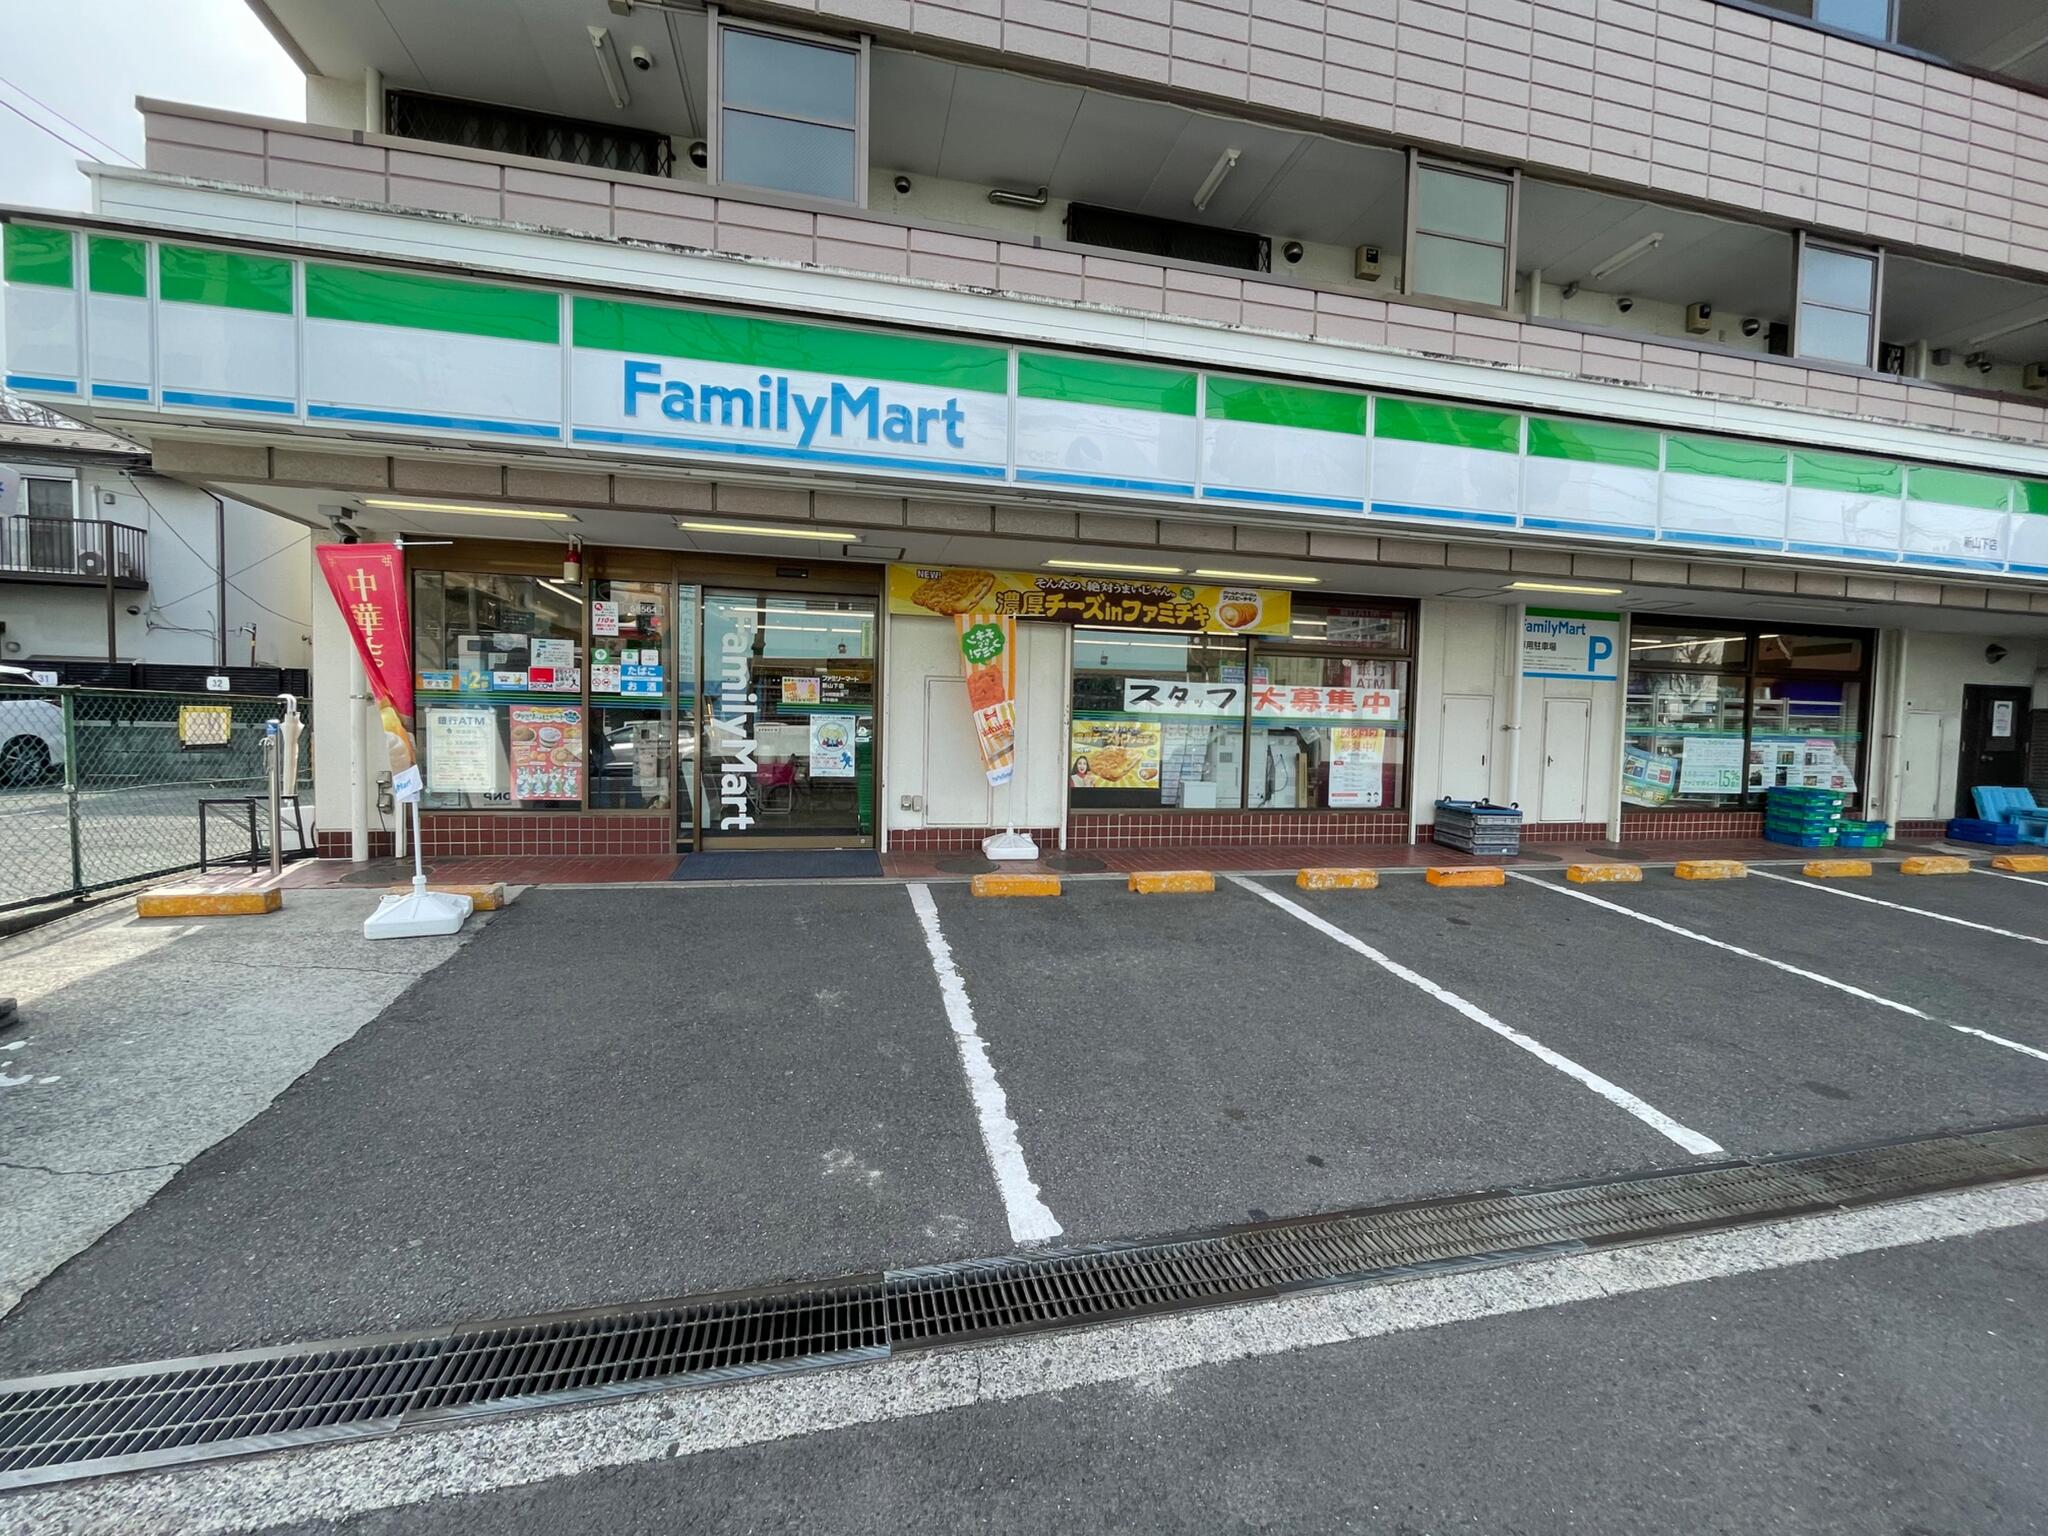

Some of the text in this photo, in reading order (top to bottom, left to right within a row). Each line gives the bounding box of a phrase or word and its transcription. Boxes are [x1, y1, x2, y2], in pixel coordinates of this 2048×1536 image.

[624, 360, 965, 449] FamilyMart
[917, 569, 942, 579] NEW!
[1035, 577, 1176, 597] そんなの、絶対うまいじゃん。
[996, 590, 1210, 627] 濃厚チーズinファミチキ
[1524, 619, 1586, 637] amilyMart
[1588, 636, 1612, 672] P
[38, 674, 49, 683] 31
[627, 666, 657, 676] たばこ
[212, 679, 223, 688] 32
[1356, 678, 1386, 690] ATM
[1129, 684, 1391, 714] スタッフ 大募集中
[438, 716, 485, 726] 銀行ATM
[713, 606, 758, 830] FamilyMart
